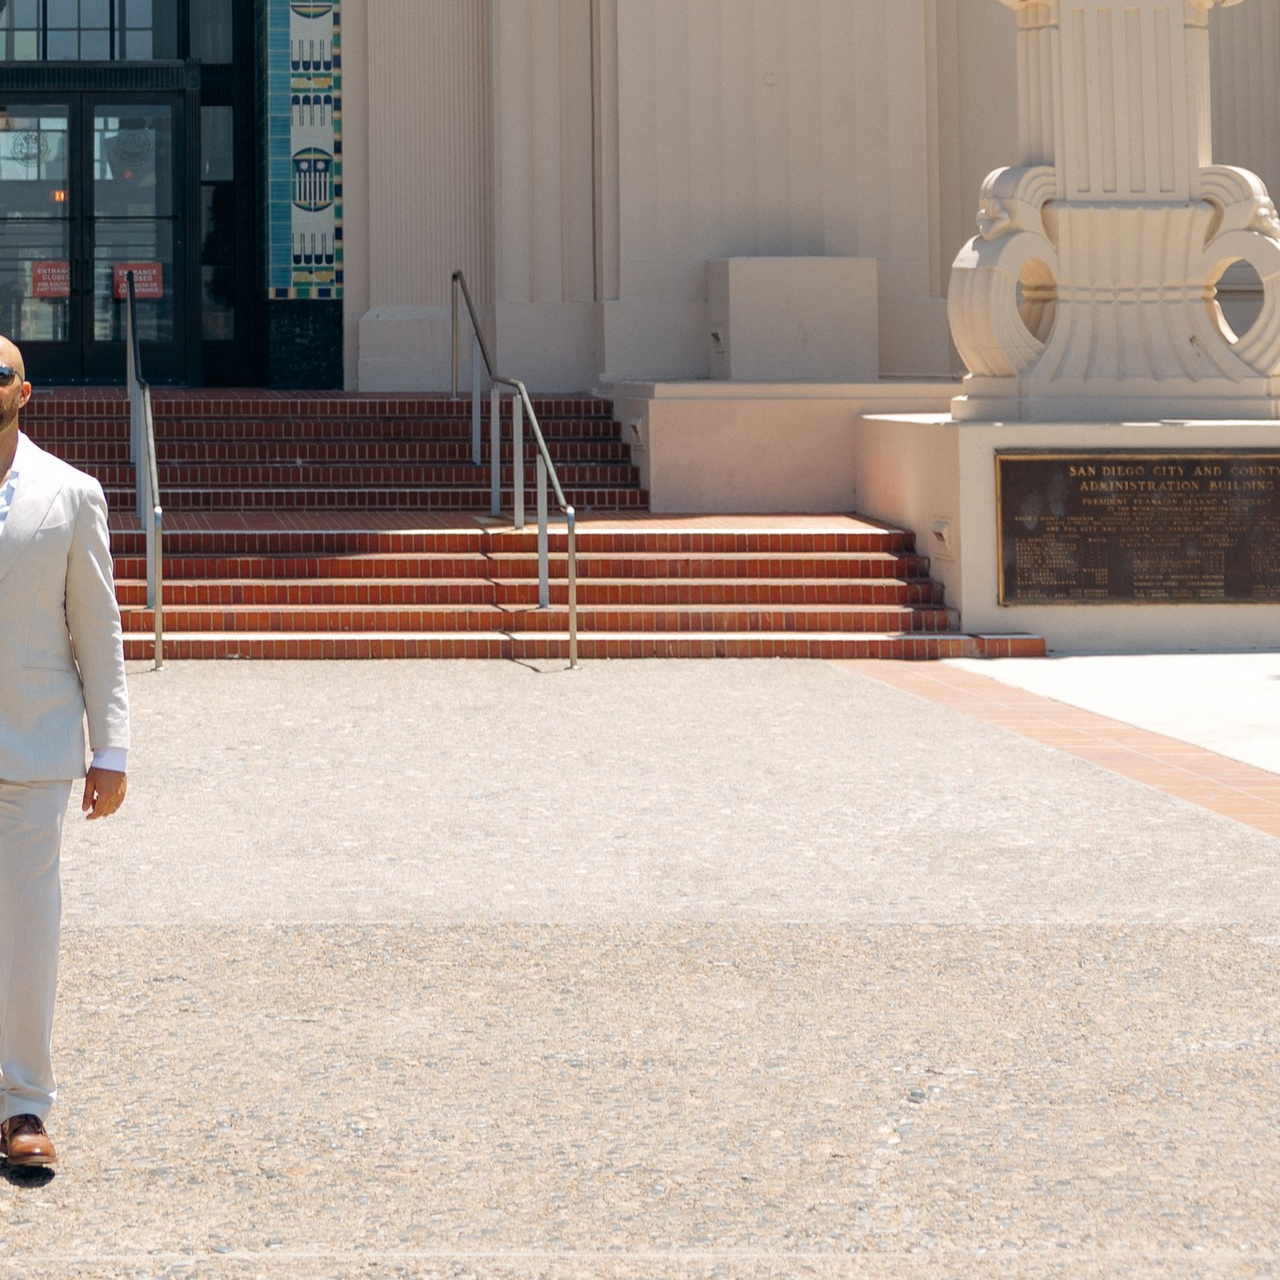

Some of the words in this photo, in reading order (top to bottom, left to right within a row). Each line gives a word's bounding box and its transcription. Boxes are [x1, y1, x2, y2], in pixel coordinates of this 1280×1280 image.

[1070, 466, 1096, 476] SAN
[1102, 466, 1145, 476] DIEGO
[1153, 466, 1185, 476] CITY
[1194, 466, 1222, 476] AND
[1080, 480, 1199, 491] ADMINISTRATION
[1209, 481, 1274, 491] BUILDING
